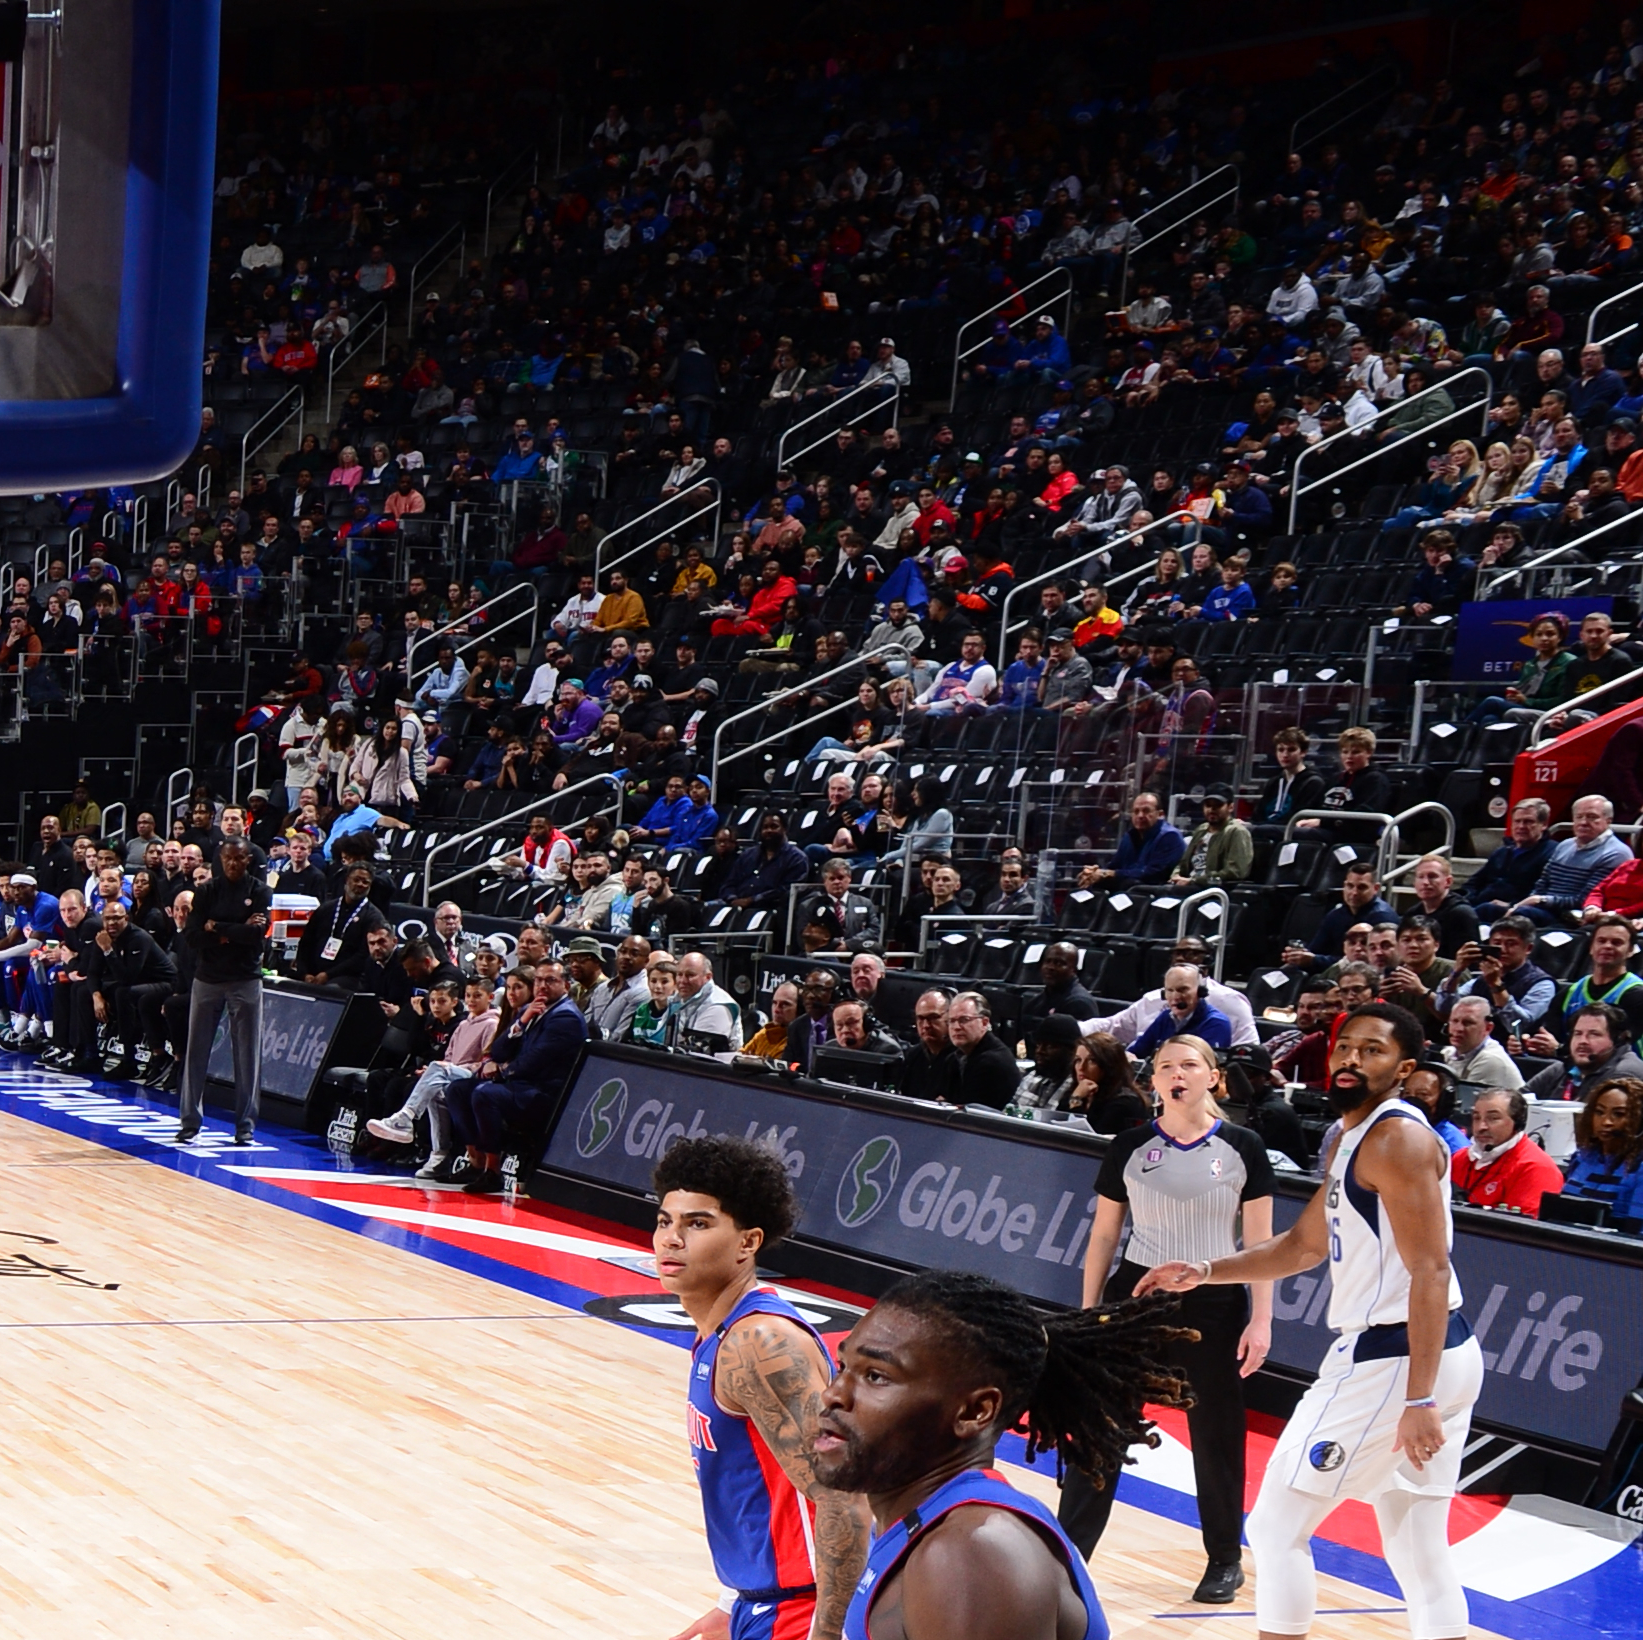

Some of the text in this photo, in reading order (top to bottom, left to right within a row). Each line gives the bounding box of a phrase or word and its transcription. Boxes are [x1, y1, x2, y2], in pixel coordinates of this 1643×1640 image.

[1534, 767, 1558, 782] 121
[286, 1023, 328, 1070] Life
[898, 1160, 1037, 1254] Globe
[1478, 1283, 1604, 1393] Life
